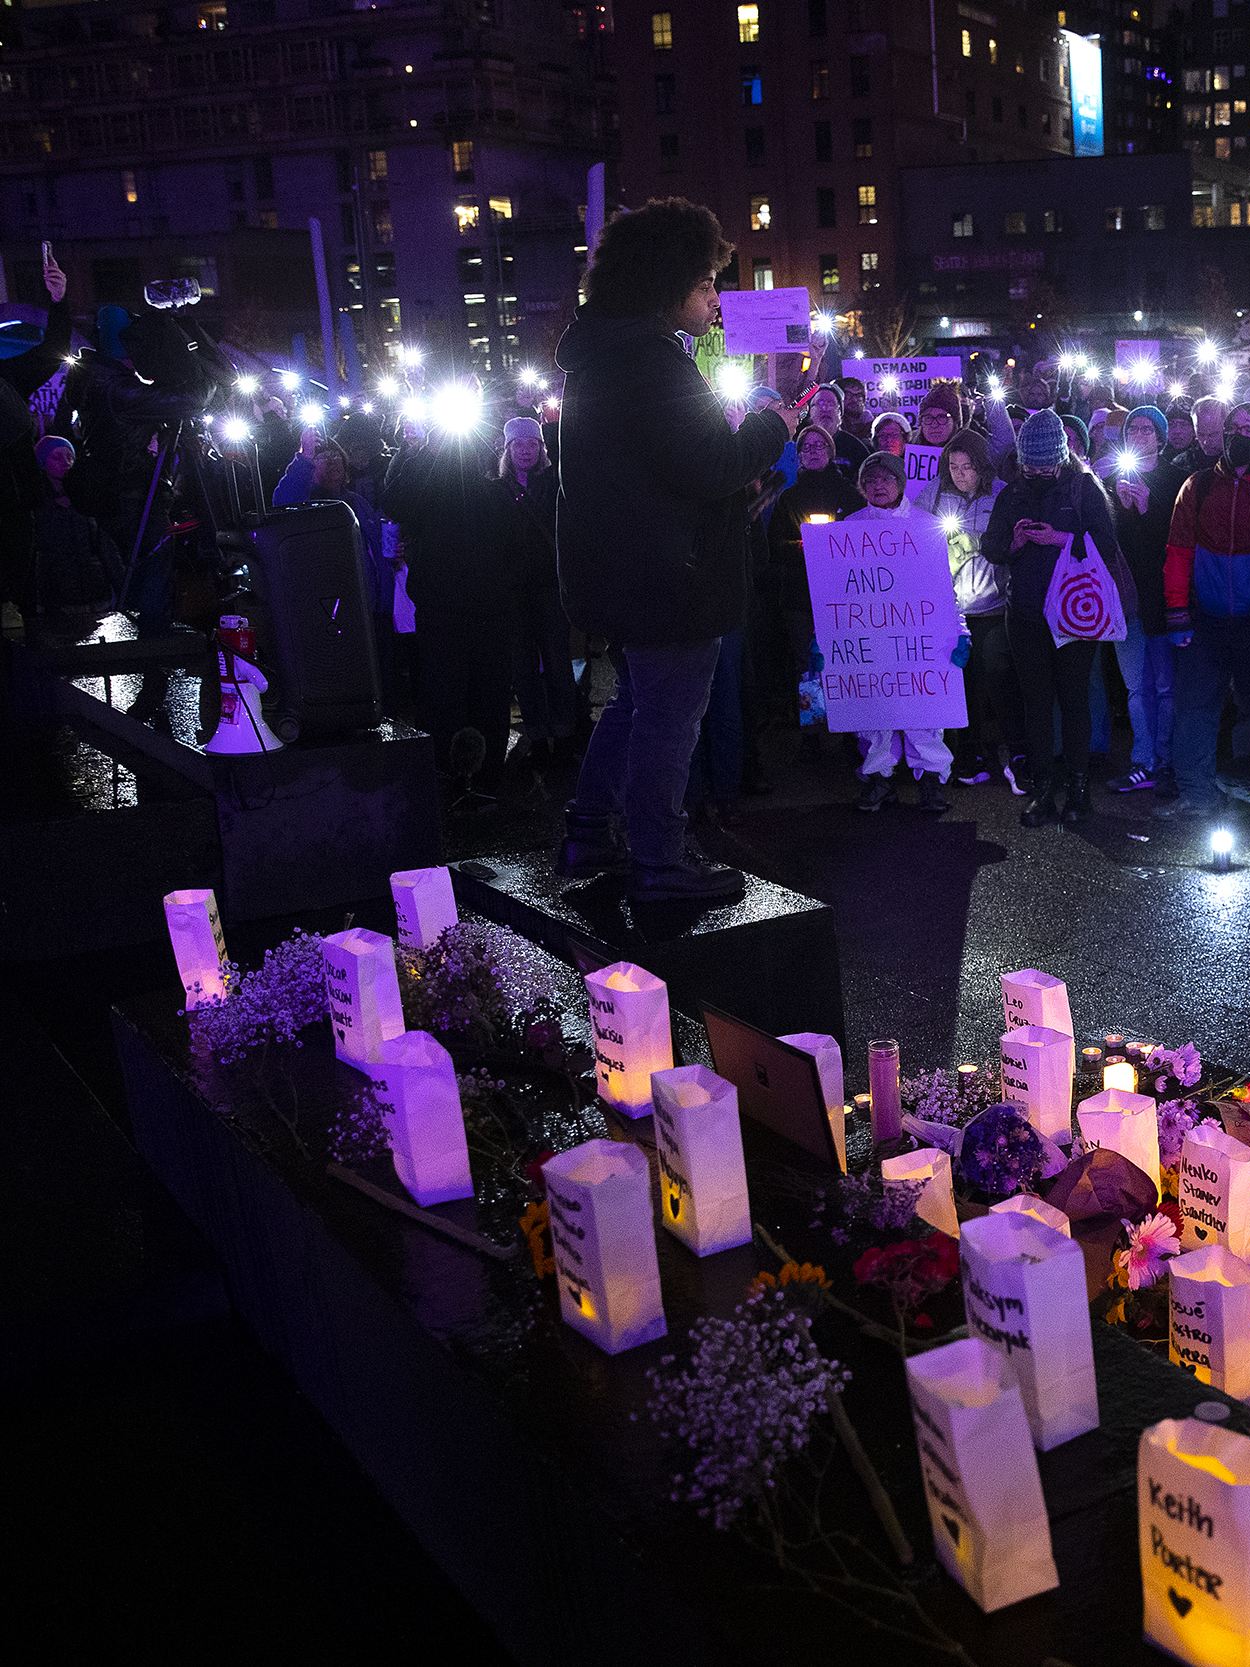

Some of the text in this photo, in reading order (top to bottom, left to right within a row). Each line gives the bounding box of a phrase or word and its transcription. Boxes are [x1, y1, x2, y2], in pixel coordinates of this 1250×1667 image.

[873, 362, 927, 374] DEMAND
[829, 530, 918, 559] MAGA
[846, 567, 894, 594] AND
[826, 600, 935, 630] TRUMP
[831, 635, 935, 664] ARE THE
[826, 669, 949, 701] EMERGENCY
[1005, 992, 1023, 1010] Leo
[1149, 1477, 1213, 1538] Keith
[1151, 1524, 1223, 1600] Porter
